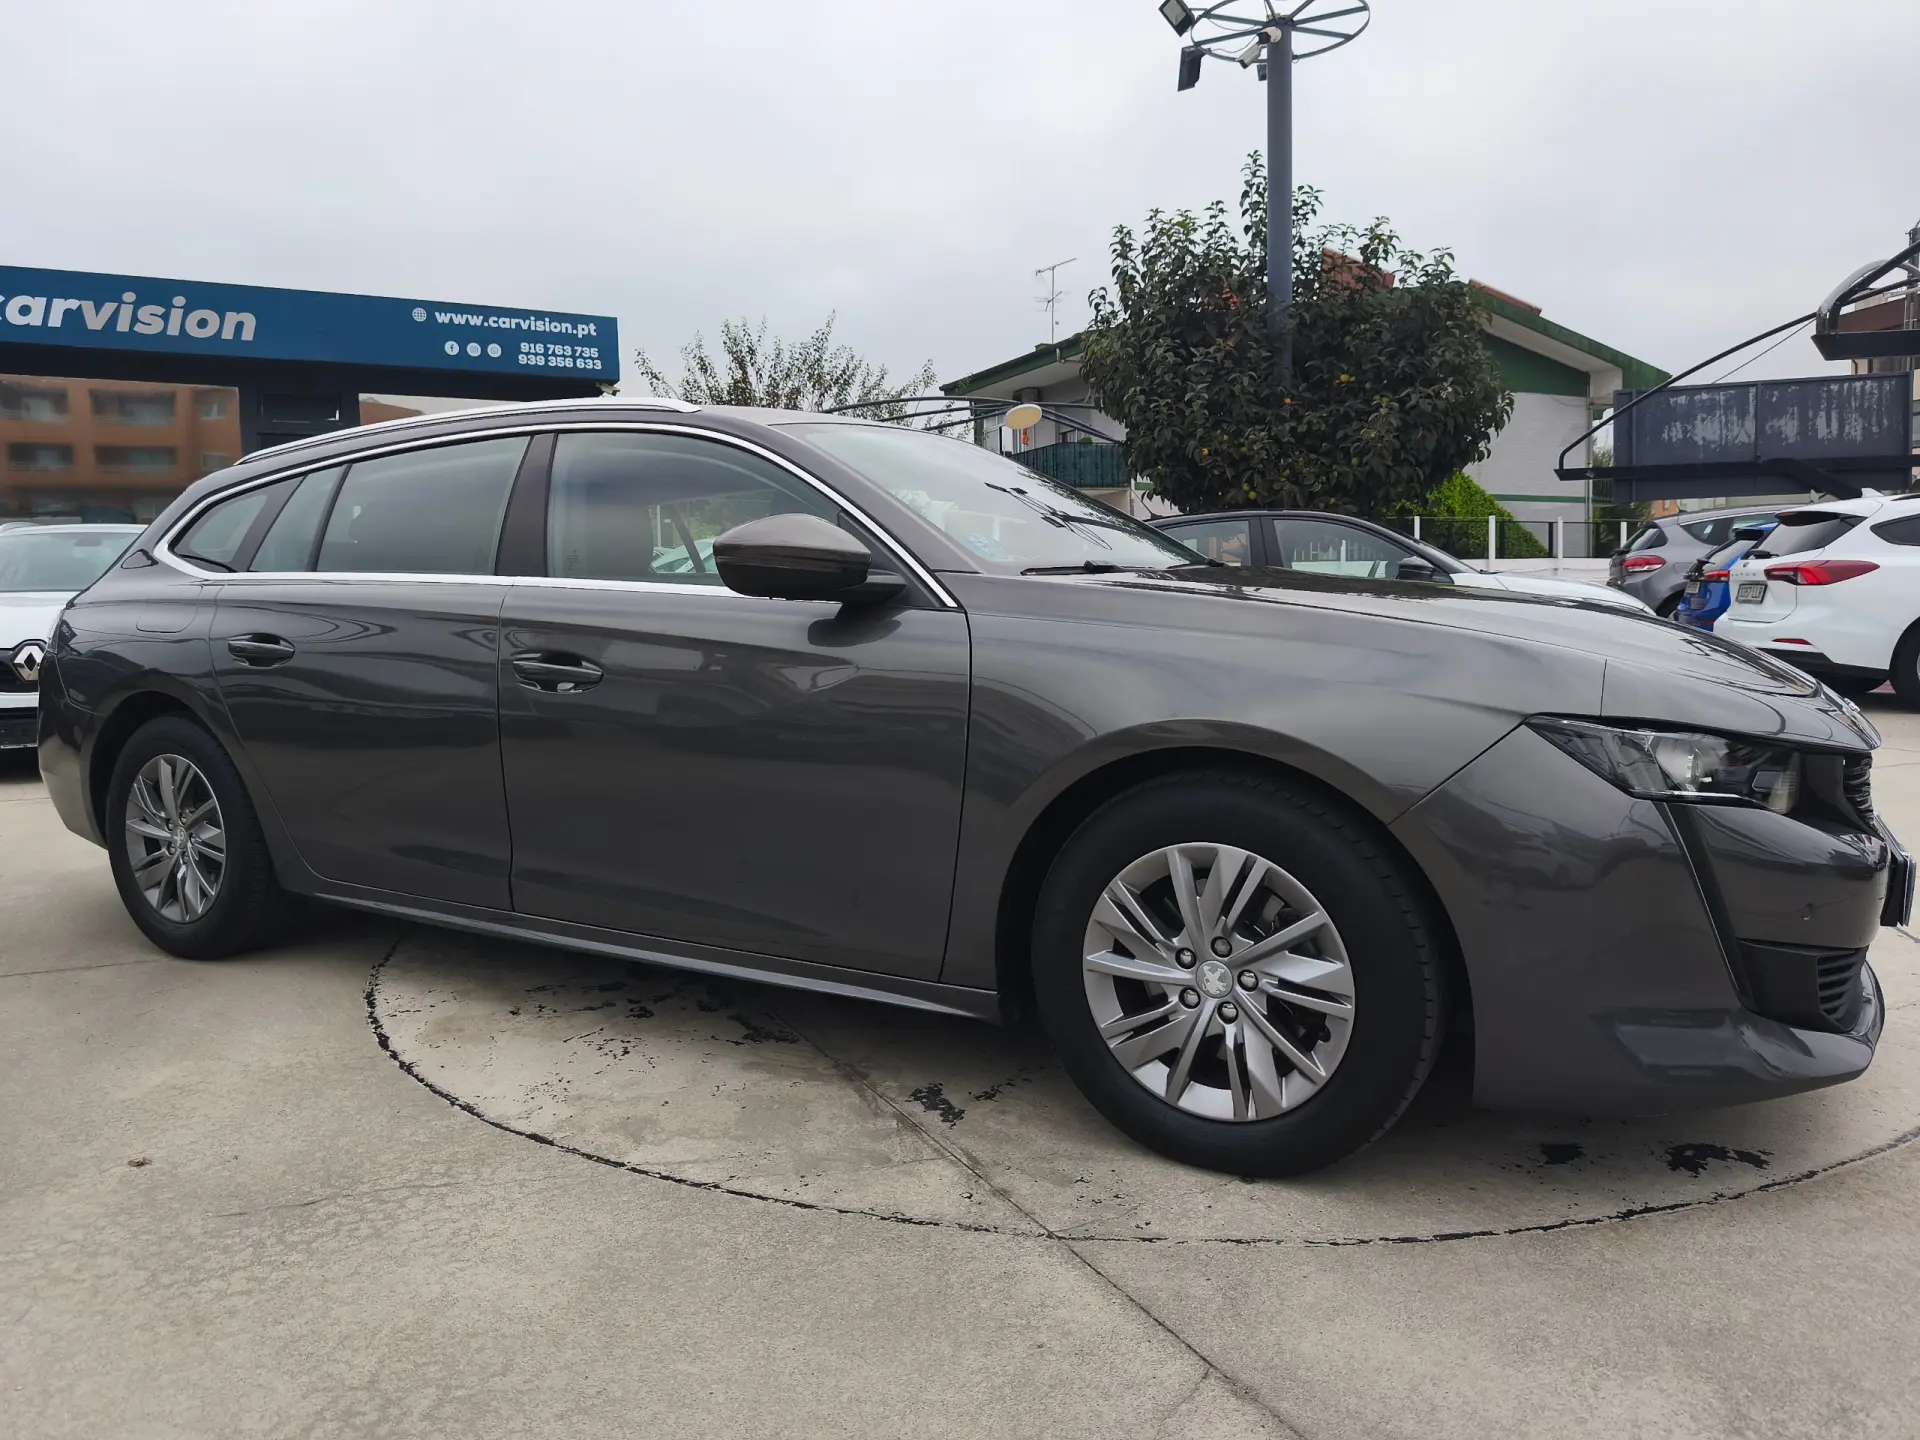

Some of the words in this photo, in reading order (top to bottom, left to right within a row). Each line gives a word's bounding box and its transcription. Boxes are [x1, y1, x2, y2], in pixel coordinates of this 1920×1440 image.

[0, 291, 256, 341] arvision
[434, 311, 597, 338] www.carvision.pt
[520, 342, 545, 354] 916
[546, 343, 572, 356] 763
[574, 346, 599, 358] 735
[518, 353, 545, 366] 939
[548, 356, 574, 368] 356
[576, 358, 602, 370] 633
